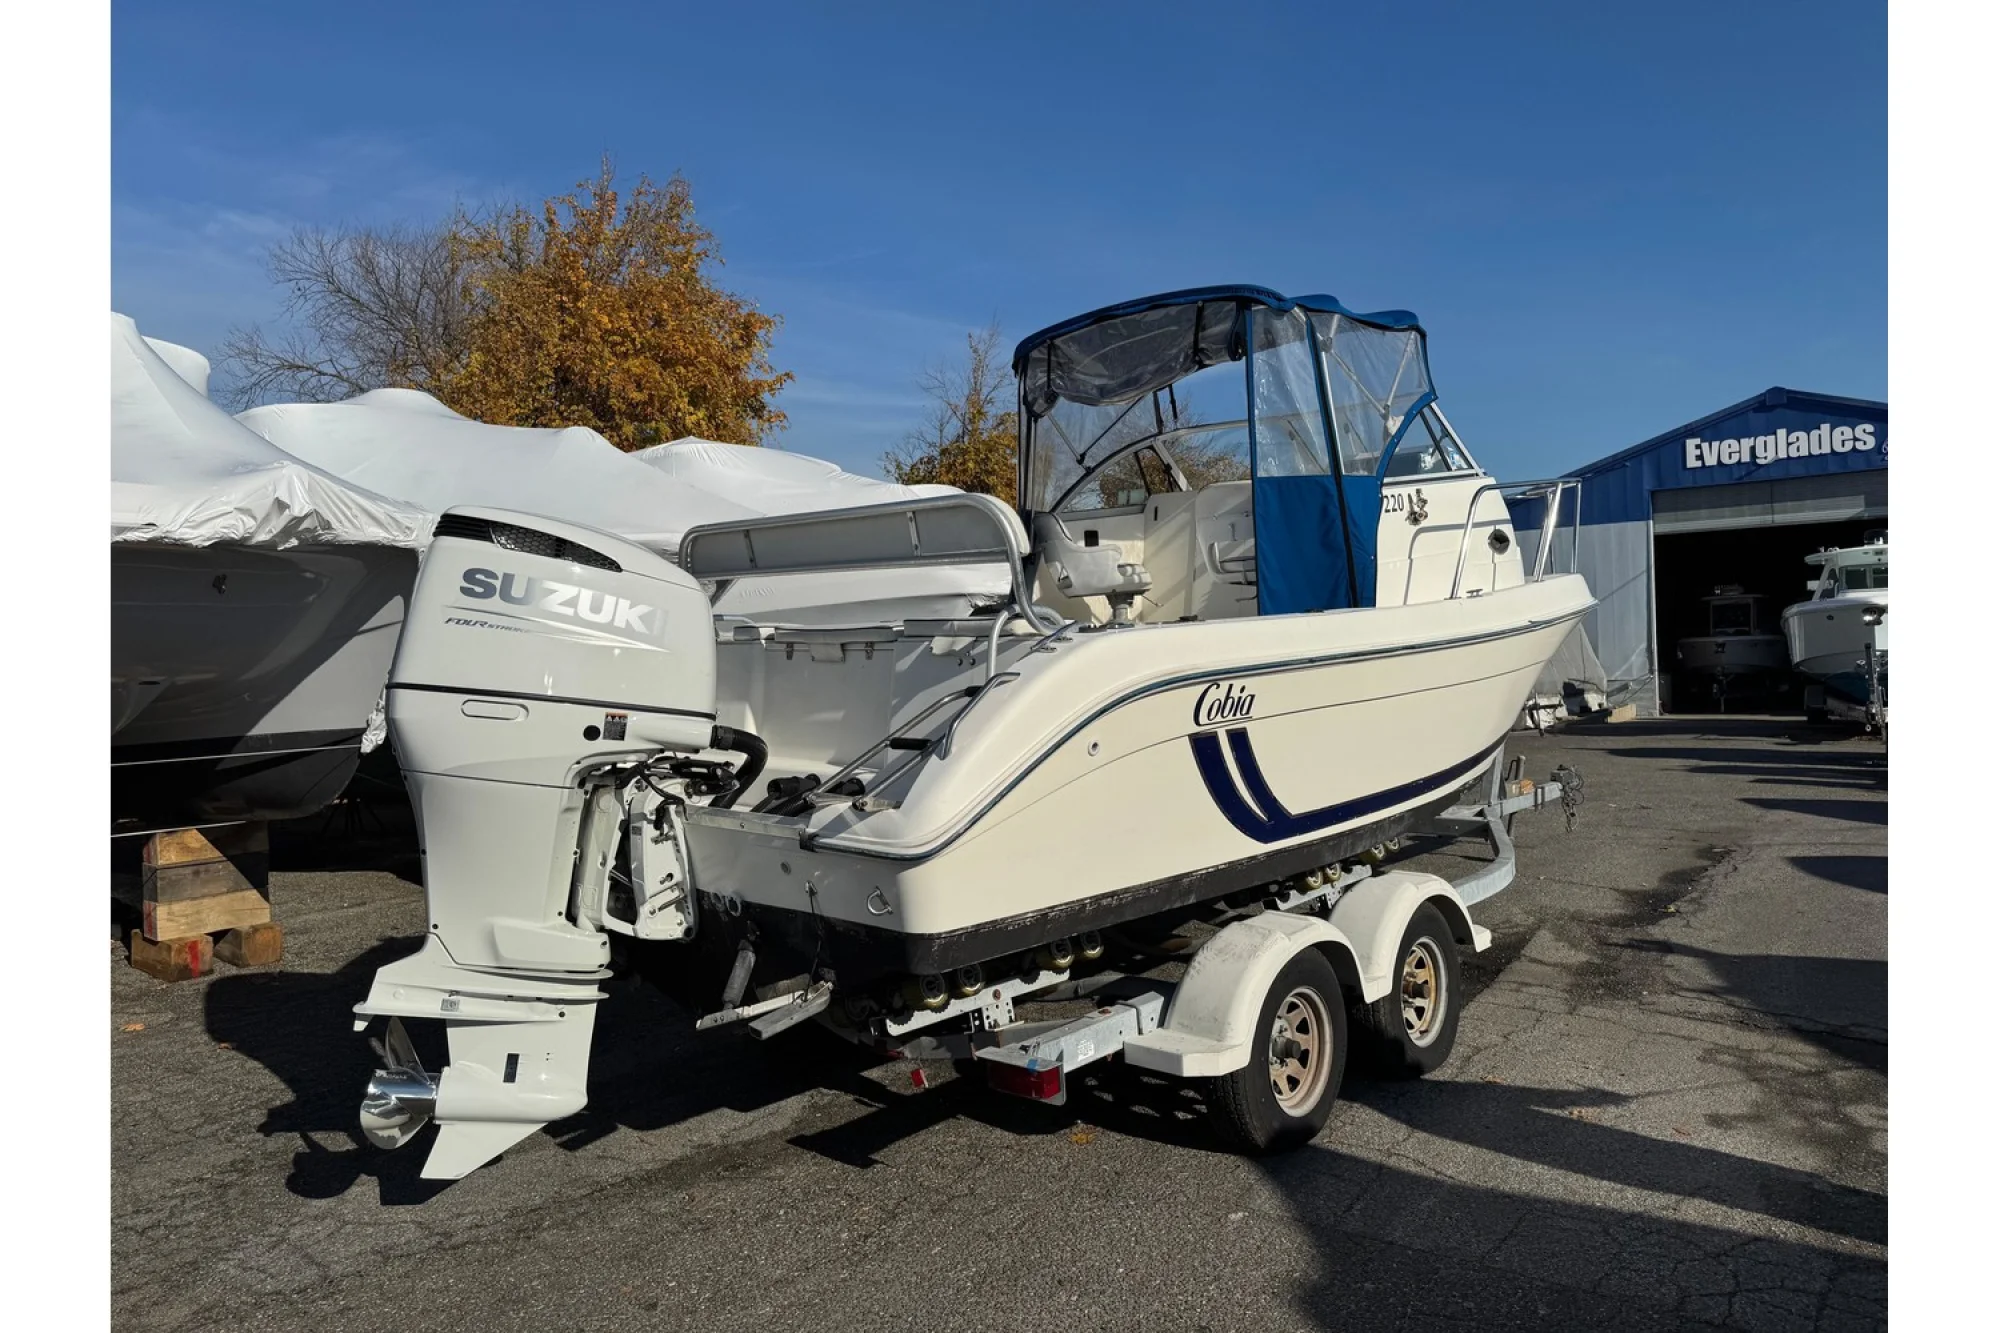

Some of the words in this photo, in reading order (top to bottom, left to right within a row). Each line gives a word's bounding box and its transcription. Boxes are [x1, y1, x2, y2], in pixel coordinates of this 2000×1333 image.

[1686, 423, 1877, 469] Everglades
[1383, 493, 1404, 513] 220
[459, 567, 668, 637] SUZUKI
[444, 617, 489, 628] FOUR
[488, 623, 531, 634] STROK
[1193, 682, 1256, 726] Cobia
